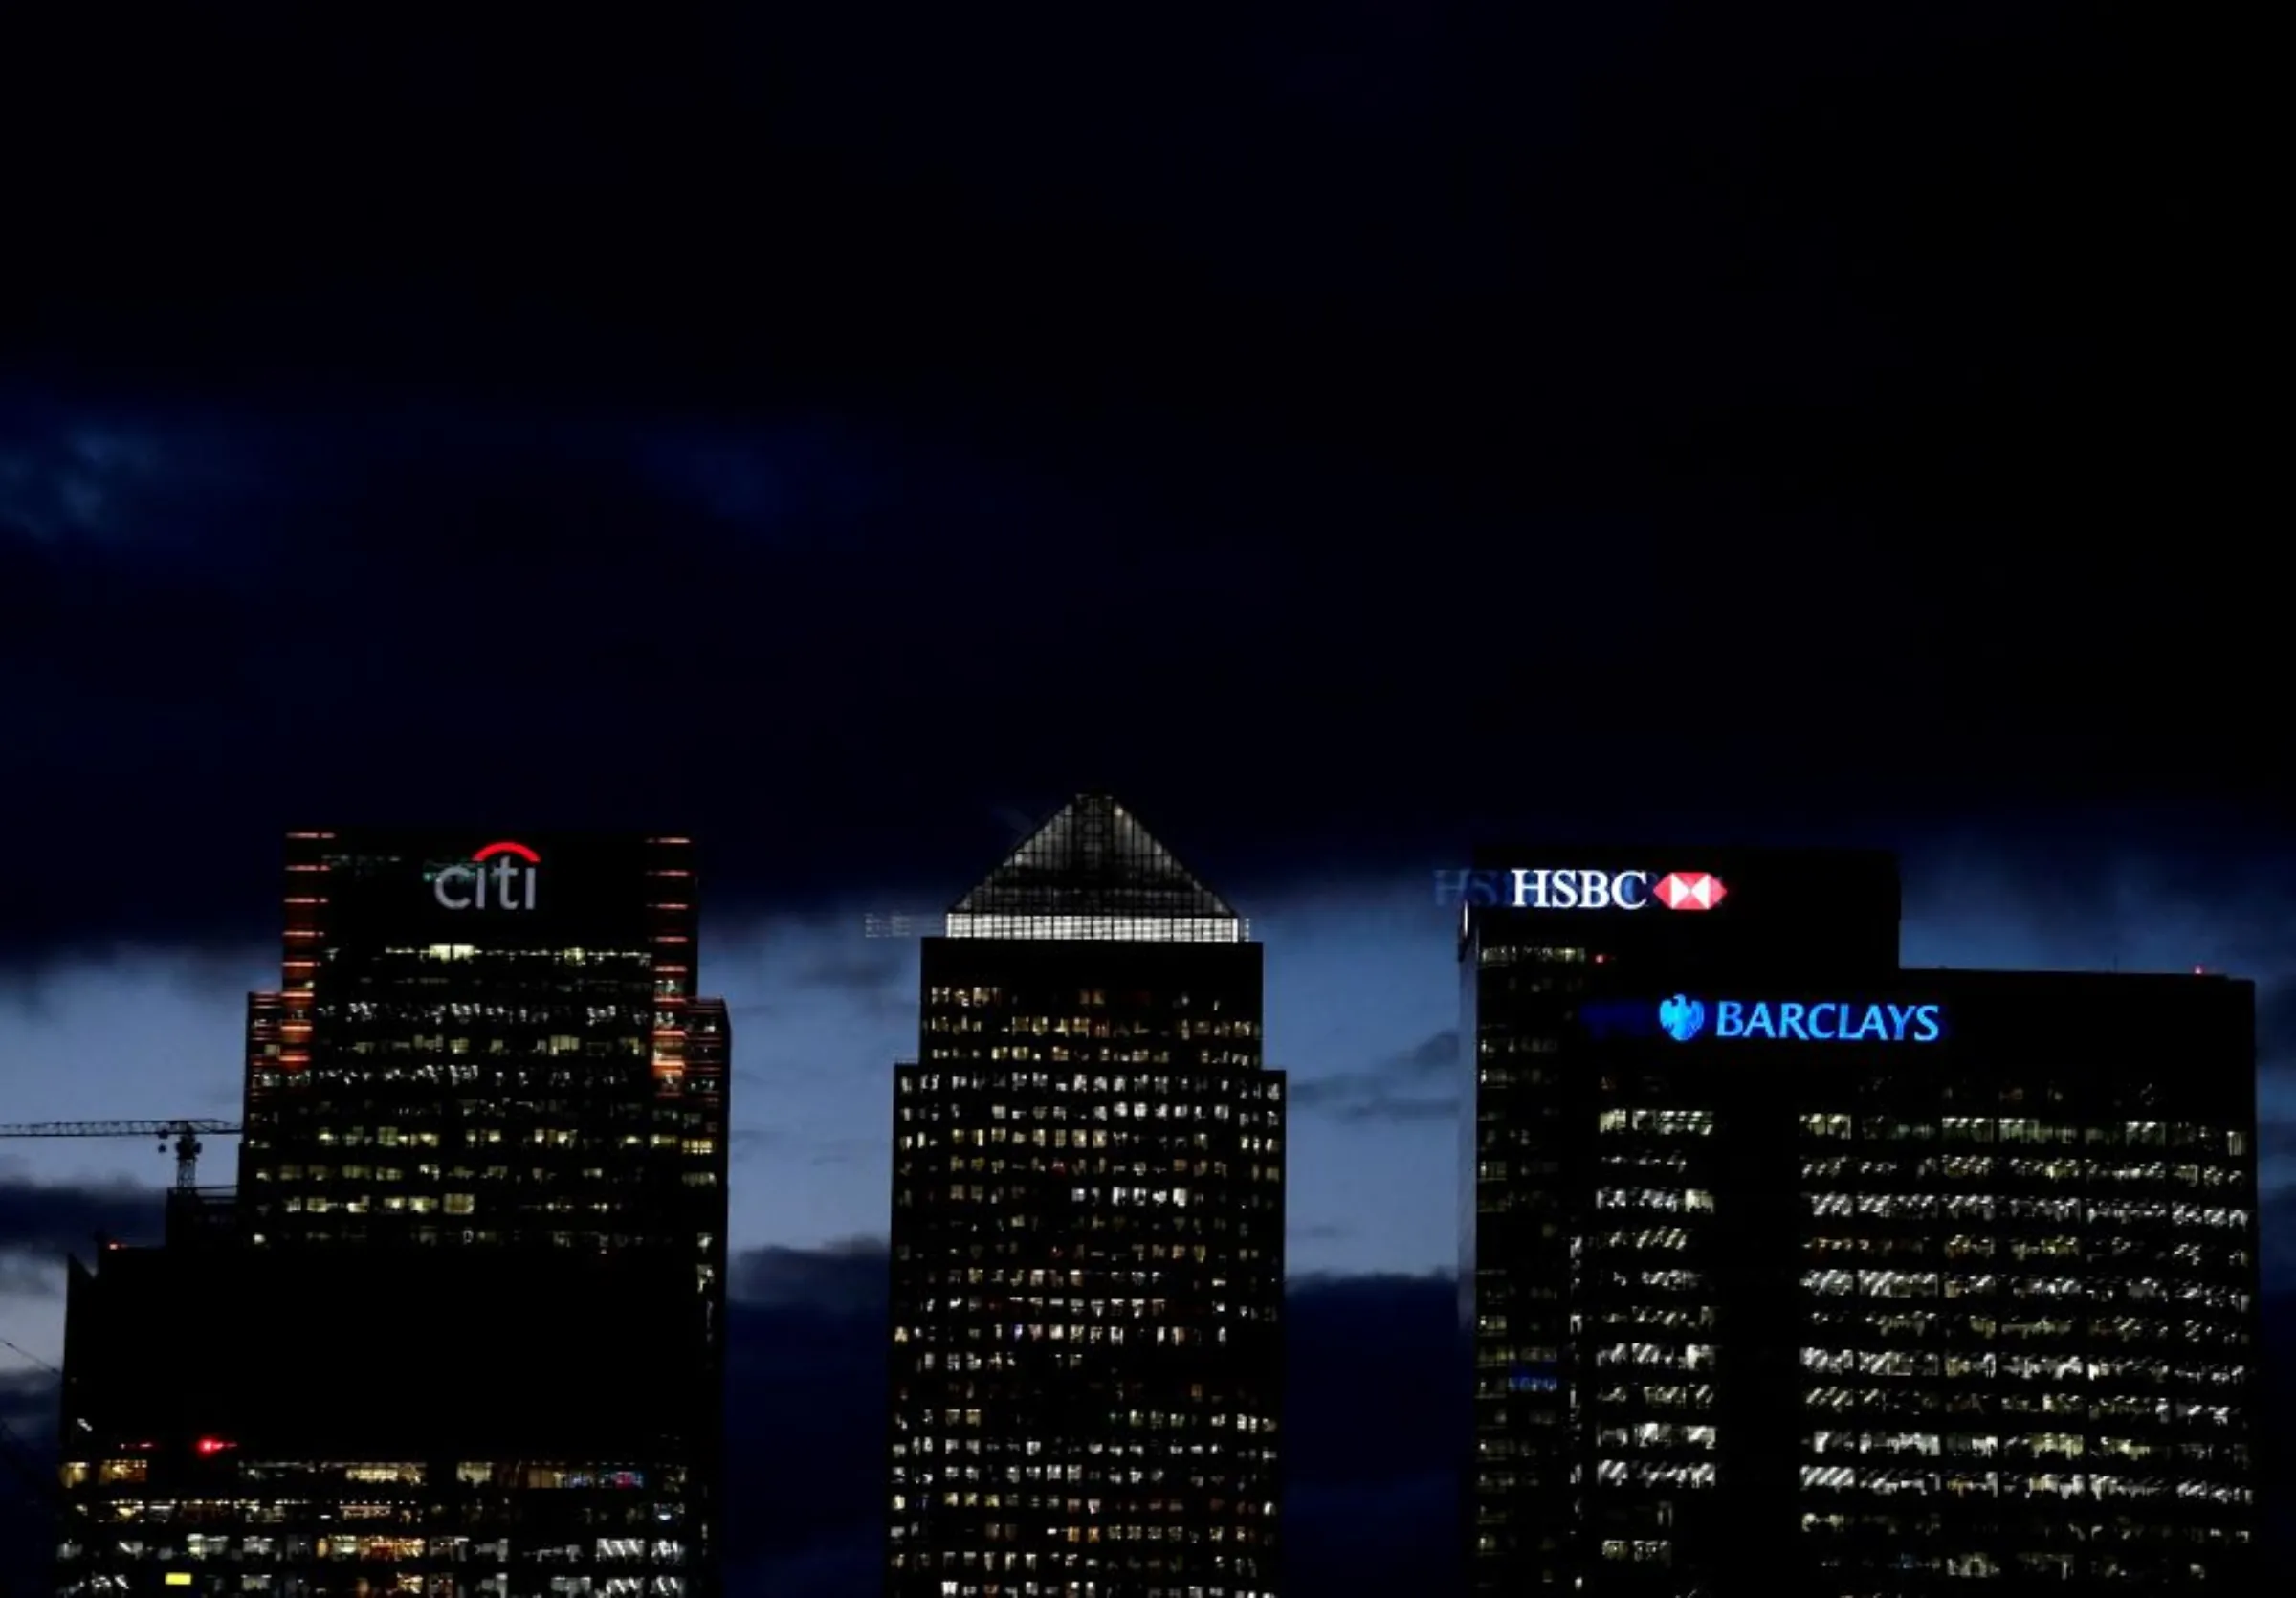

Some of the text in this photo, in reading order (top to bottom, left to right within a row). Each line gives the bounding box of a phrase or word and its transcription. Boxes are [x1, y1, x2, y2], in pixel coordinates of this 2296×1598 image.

[434, 854, 537, 911] citi
[1511, 868, 1647, 909] HSBC
[1715, 1001, 1940, 1042] BARCLAYS
